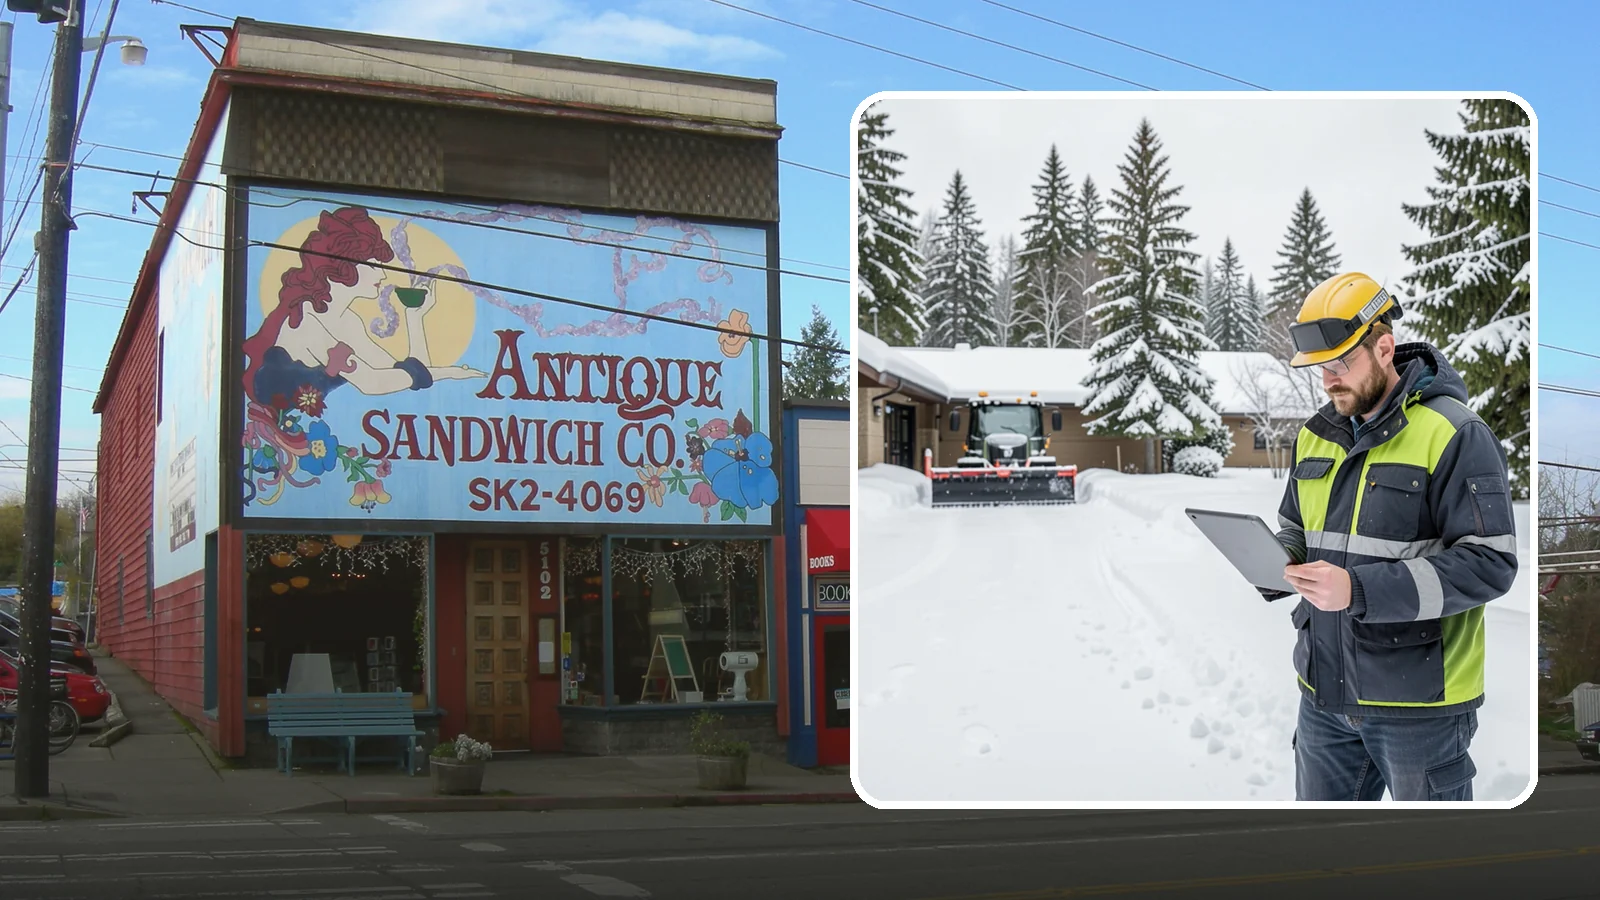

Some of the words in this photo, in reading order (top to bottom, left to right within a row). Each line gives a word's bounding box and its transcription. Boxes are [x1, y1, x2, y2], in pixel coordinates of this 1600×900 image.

[476, 329, 723, 420] ANTIQUE
[361, 409, 604, 466] SANDWICH
[617, 422, 685, 468] CO.
[468, 477, 646, 512] SK2-4069
[540, 541, 551, 599] 5102
[809, 555, 834, 569] BOOKS
